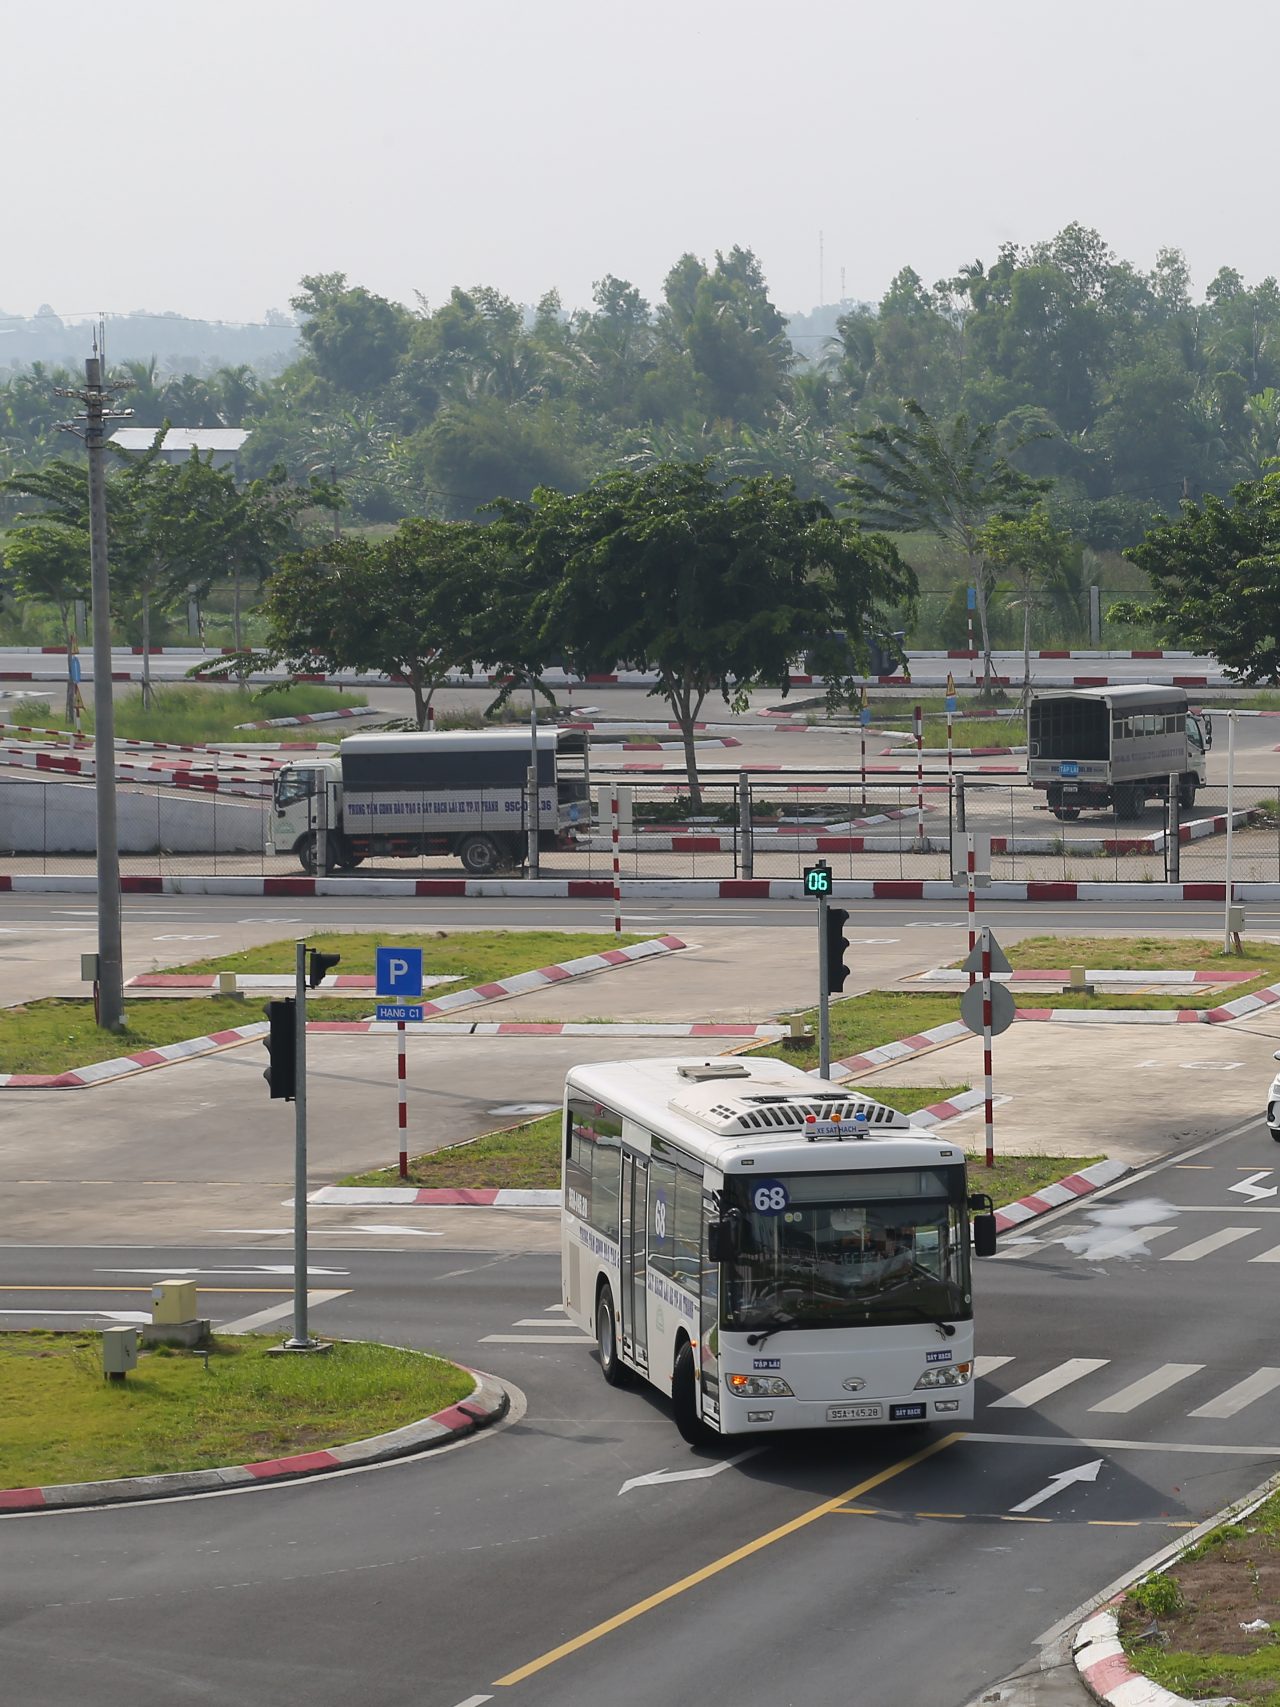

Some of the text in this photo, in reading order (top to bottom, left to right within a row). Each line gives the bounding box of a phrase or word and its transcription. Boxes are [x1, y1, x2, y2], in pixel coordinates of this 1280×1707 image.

[505, 801, 552, 812] 95C-0.36
[808, 872, 828, 890] 06
[390, 958, 408, 985] P
[409, 1008, 419, 1018] C1
[754, 1187, 786, 1210] 68
[655, 1200, 666, 1239] 68
